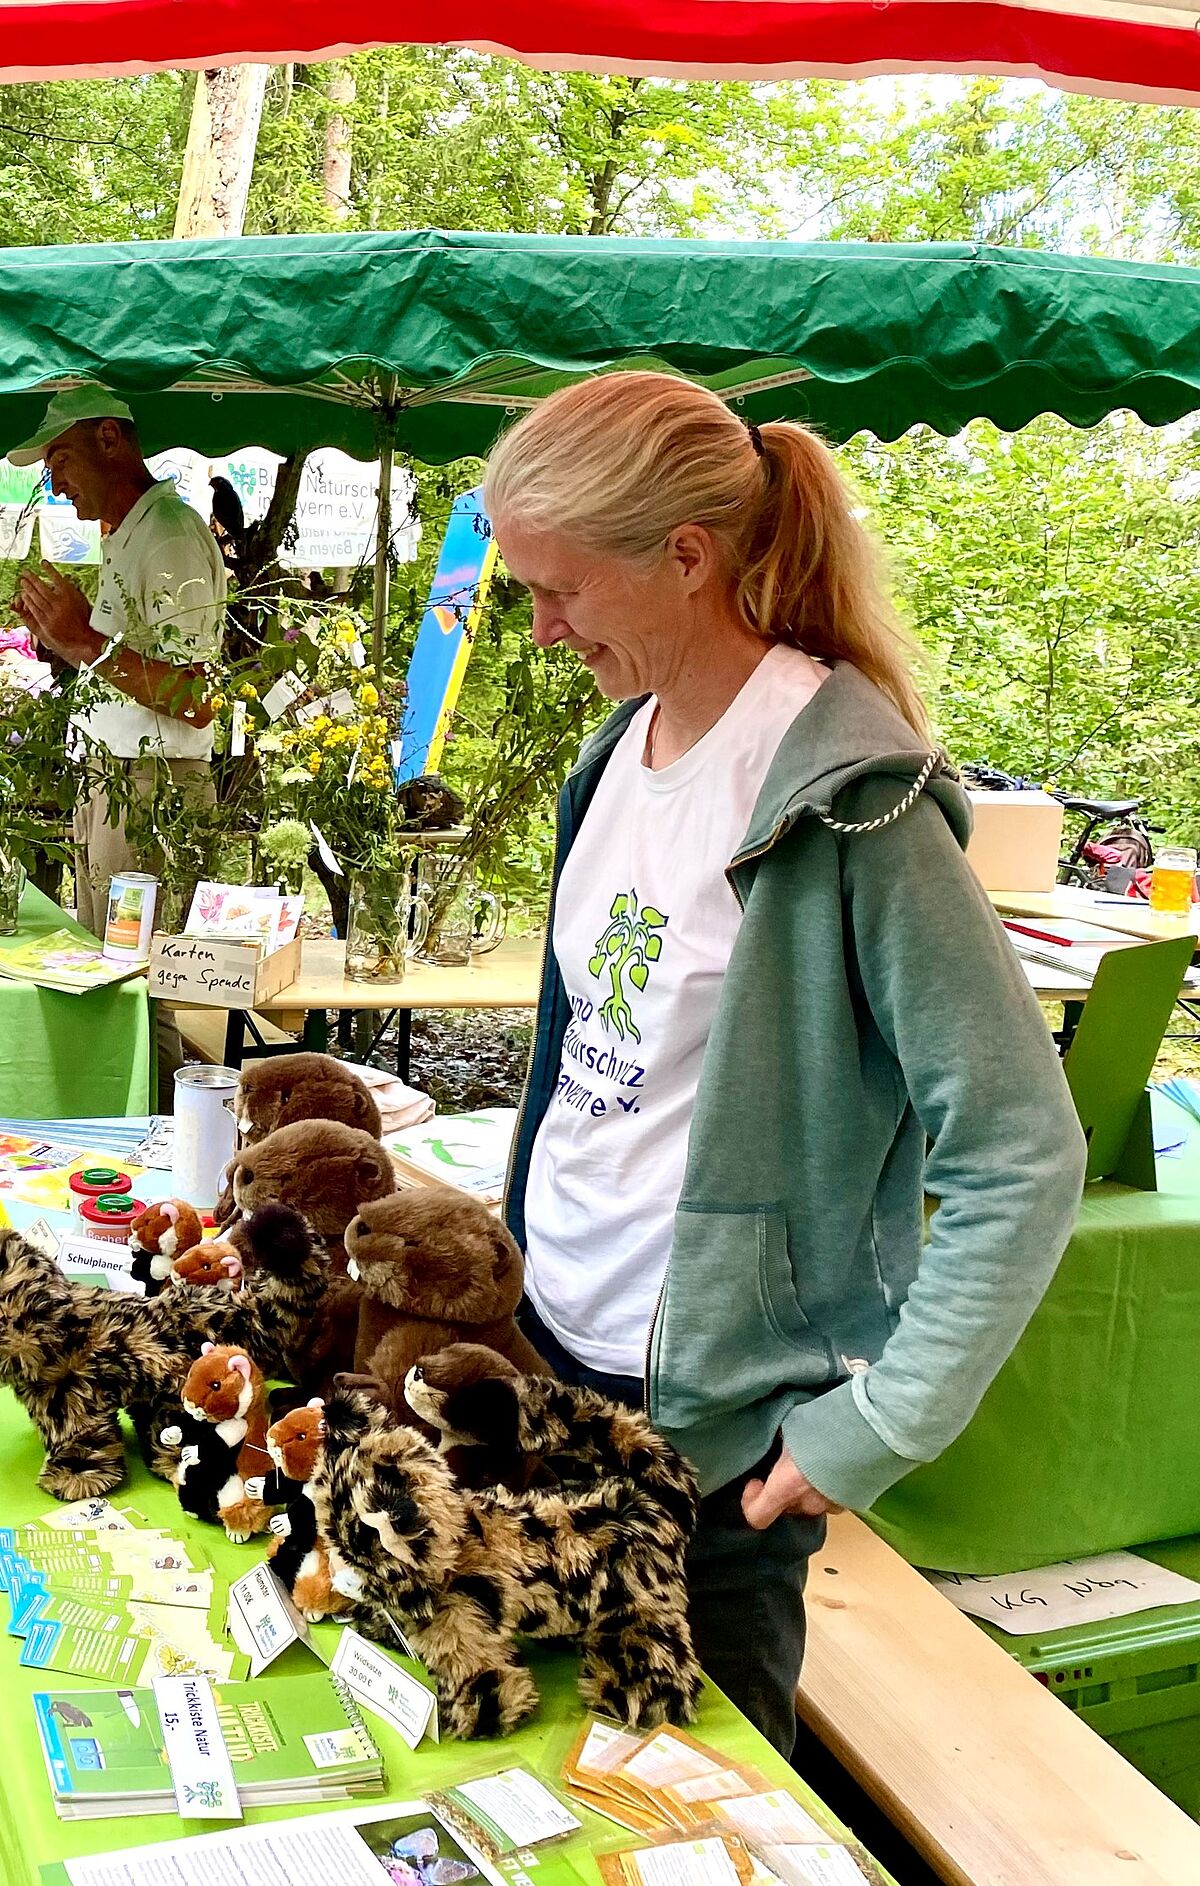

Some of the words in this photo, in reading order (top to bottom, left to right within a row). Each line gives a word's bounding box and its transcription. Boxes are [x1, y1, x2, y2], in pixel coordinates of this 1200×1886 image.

[160, 943, 216, 961] Karten
[157, 969, 188, 989] gegen
[196, 968, 251, 991] Spende
[563, 1021, 645, 1088] aturschutz
[66, 1252, 124, 1272] Schulplaner
[182, 1681, 204, 1727] Trickkiste
[193, 1728, 211, 1757] Natur
